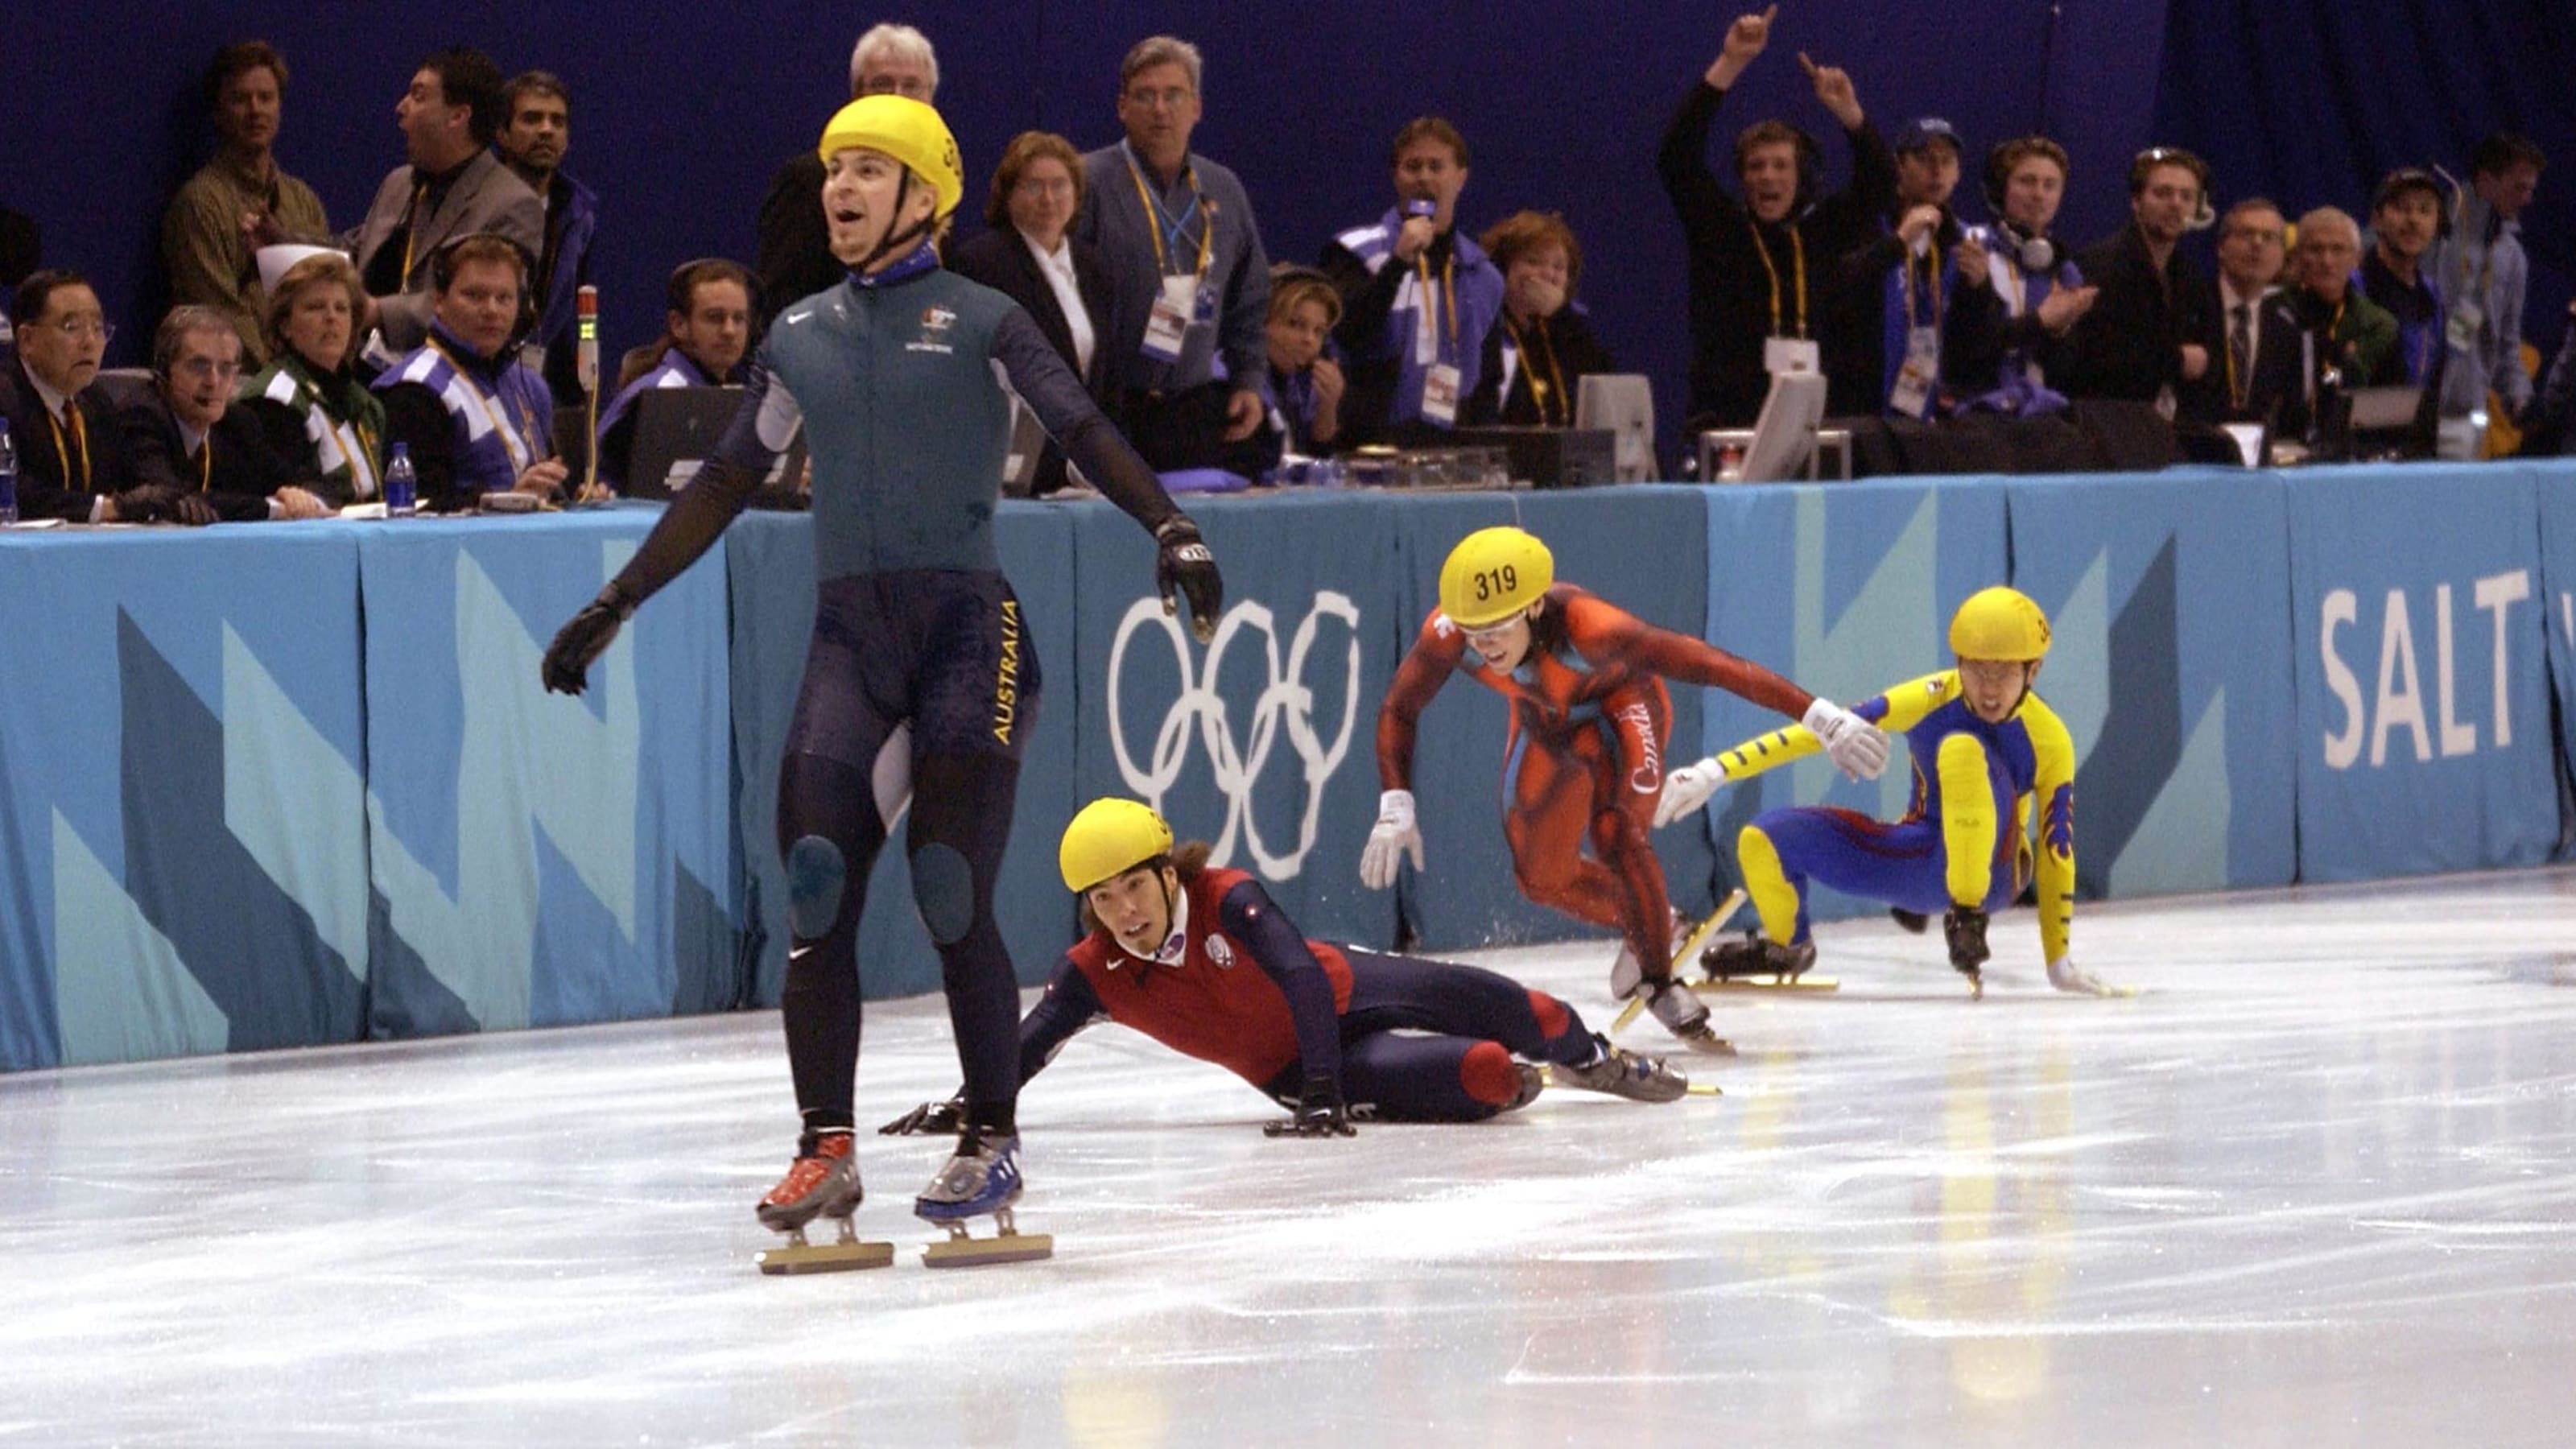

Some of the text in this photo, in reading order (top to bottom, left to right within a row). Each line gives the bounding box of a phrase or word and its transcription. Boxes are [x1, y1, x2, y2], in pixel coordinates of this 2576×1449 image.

[1473, 564, 1517, 601] 319
[993, 600, 1019, 745] AUSTRALIA
[2322, 568, 2530, 770] SALT
[1613, 702, 1660, 795] Canada
